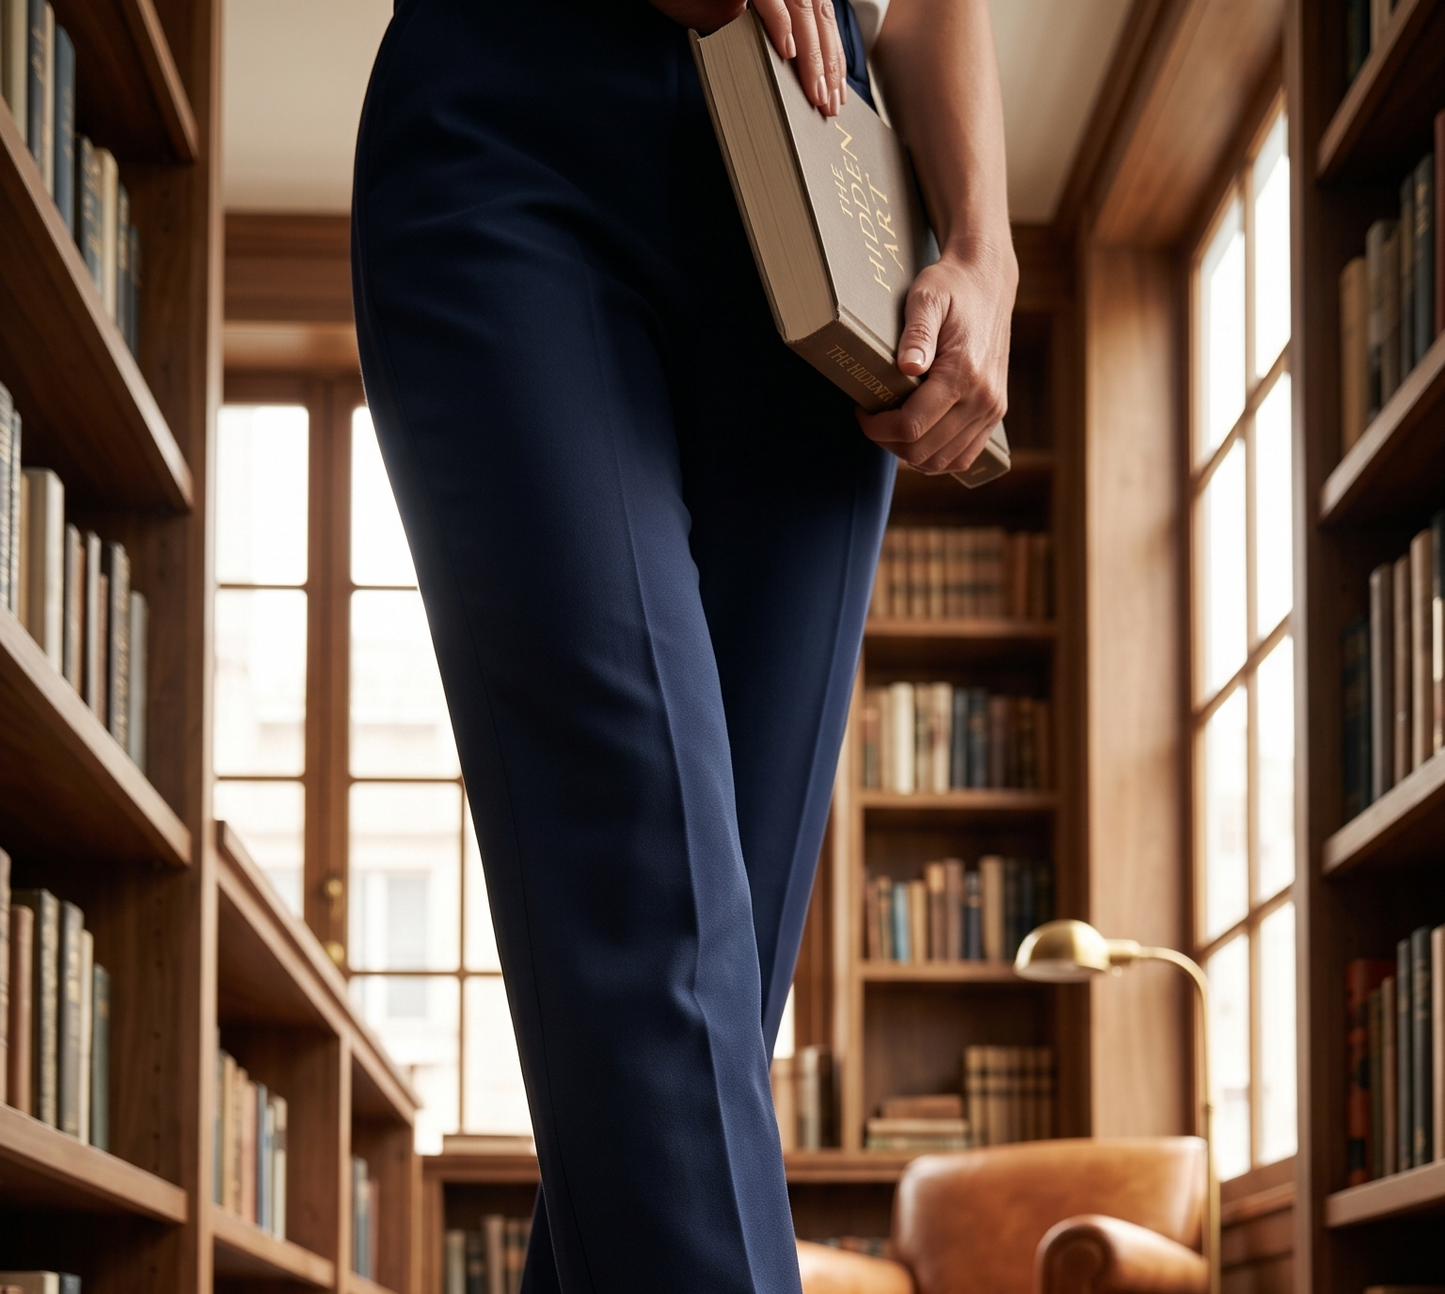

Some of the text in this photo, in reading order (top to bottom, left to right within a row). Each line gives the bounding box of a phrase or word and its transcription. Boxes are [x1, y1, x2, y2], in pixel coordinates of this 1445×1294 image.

[830, 163, 854, 218] THE
[834, 121, 892, 293] HIDDEN
[865, 173, 905, 272] ART
[826, 344, 855, 368] THE
